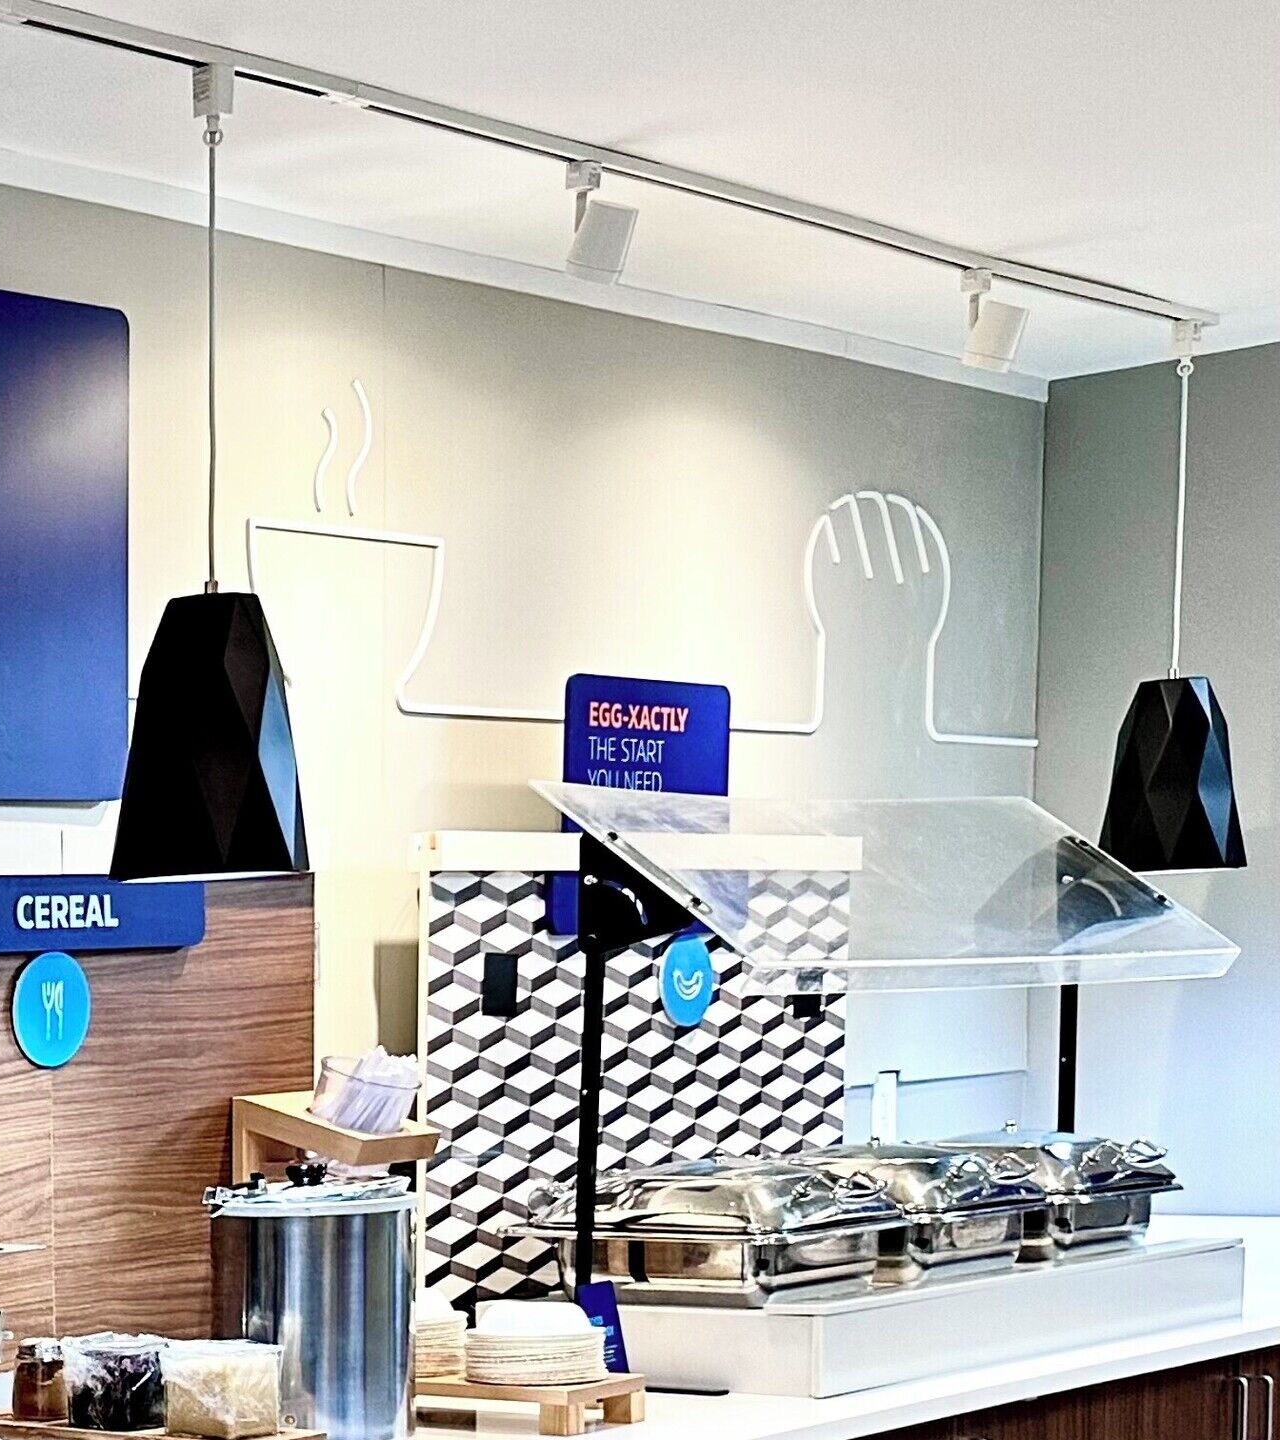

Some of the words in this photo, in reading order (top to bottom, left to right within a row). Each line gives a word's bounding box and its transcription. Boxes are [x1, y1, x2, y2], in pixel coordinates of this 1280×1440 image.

[588, 701, 690, 733] EGG-XACTLY
[587, 735, 617, 762] THE
[620, 738, 666, 764] START
[587, 768, 620, 788] YOU
[624, 770, 663, 792] NEED
[16, 894, 120, 930] CEREAL
